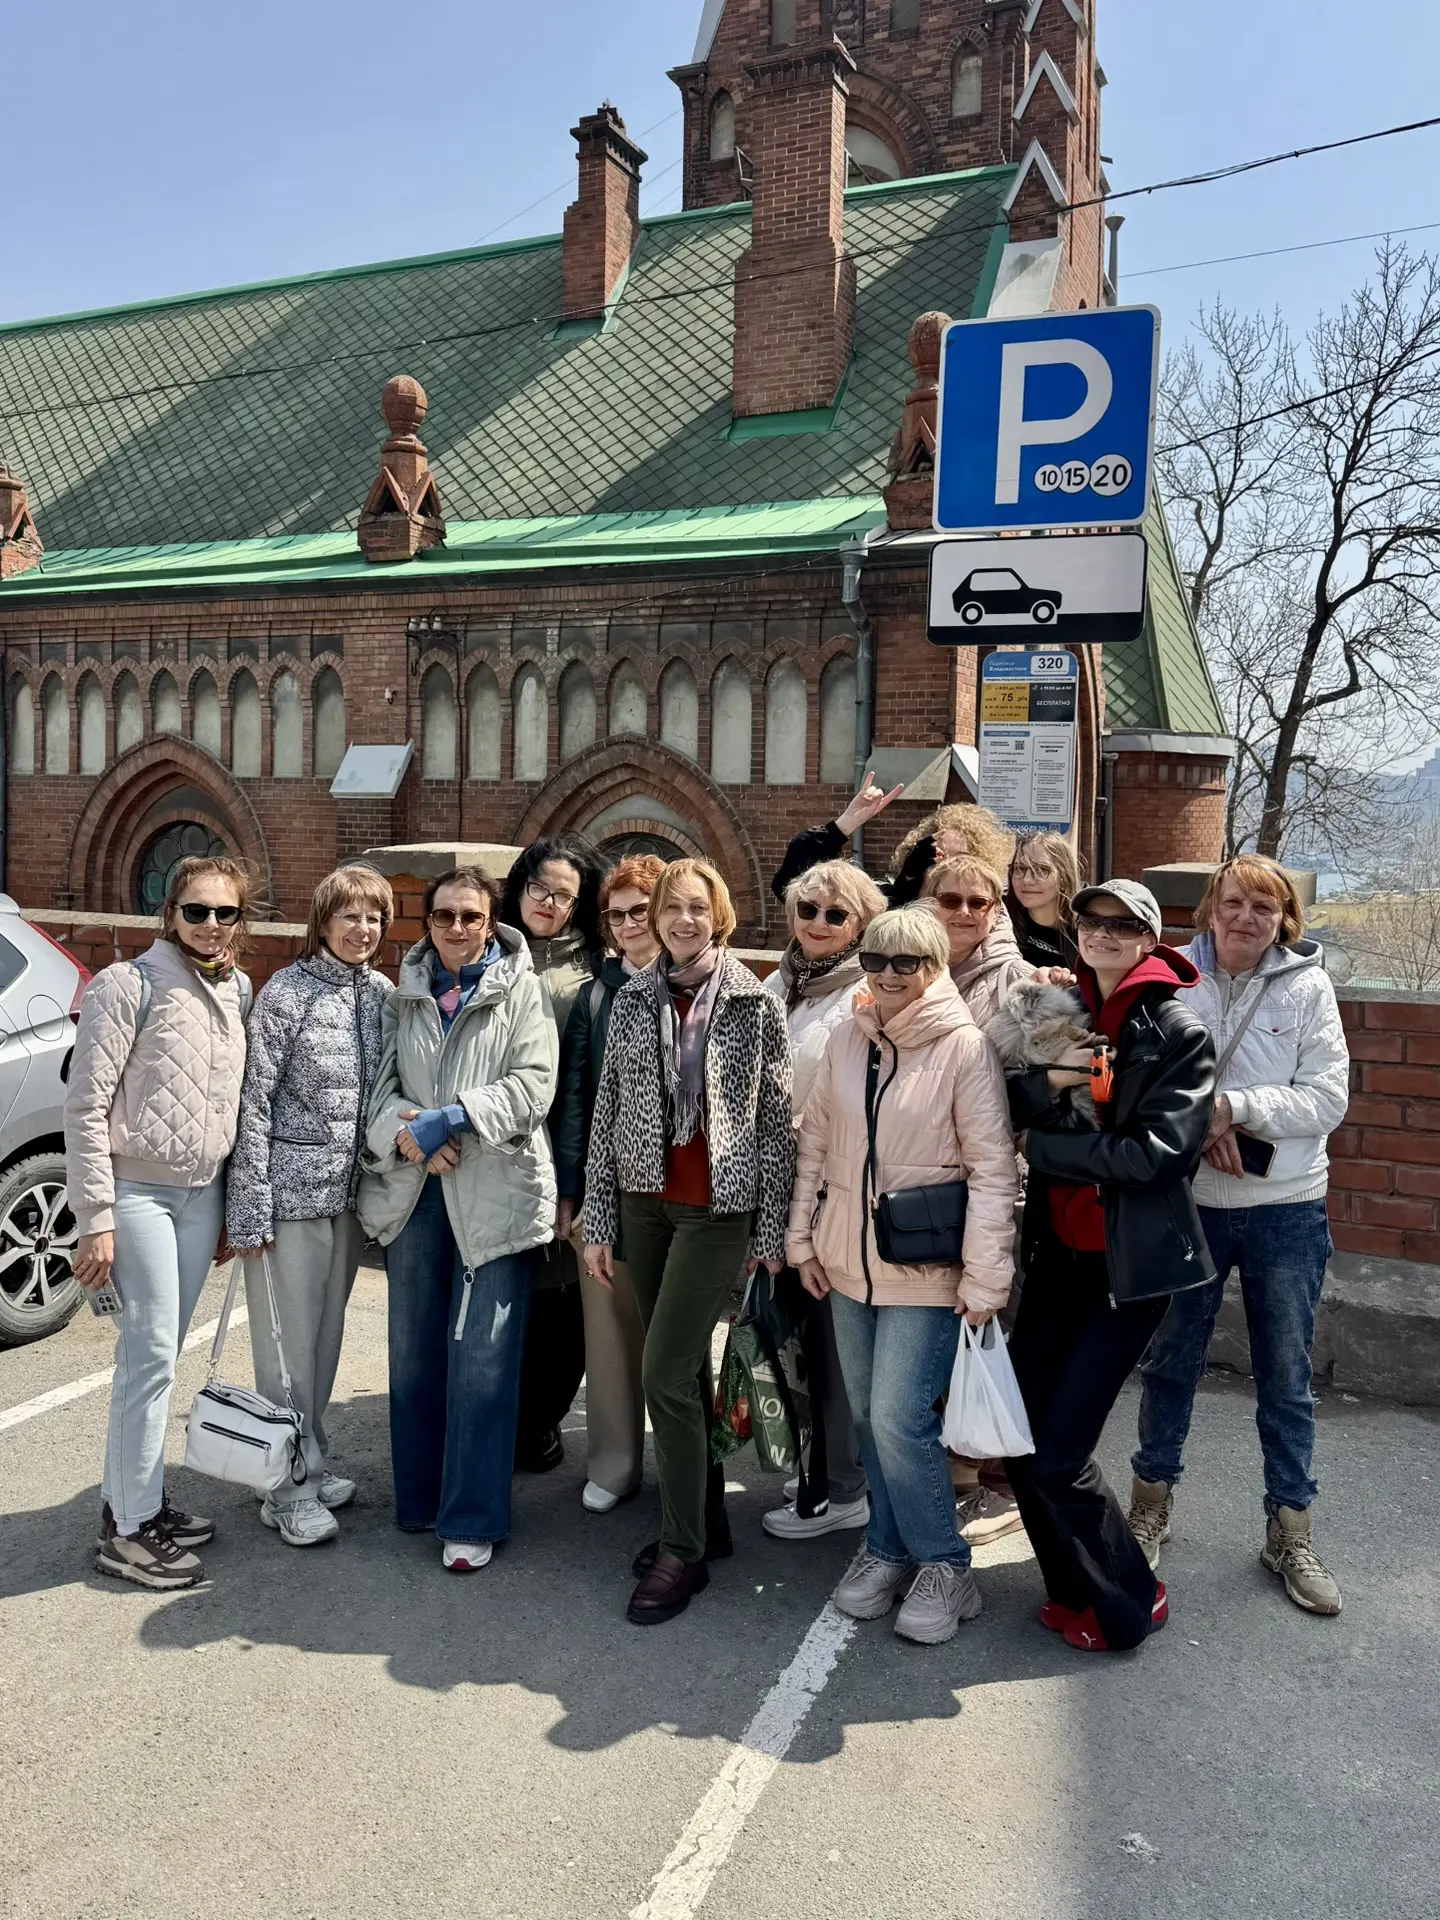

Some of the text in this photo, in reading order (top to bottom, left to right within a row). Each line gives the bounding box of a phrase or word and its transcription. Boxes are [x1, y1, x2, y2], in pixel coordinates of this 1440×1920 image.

[994, 338, 1113, 505] P
[1040, 463, 1128, 487] 10 15 20
[1038, 657, 1063, 669] 320
[1001, 692, 1014, 702] 75
